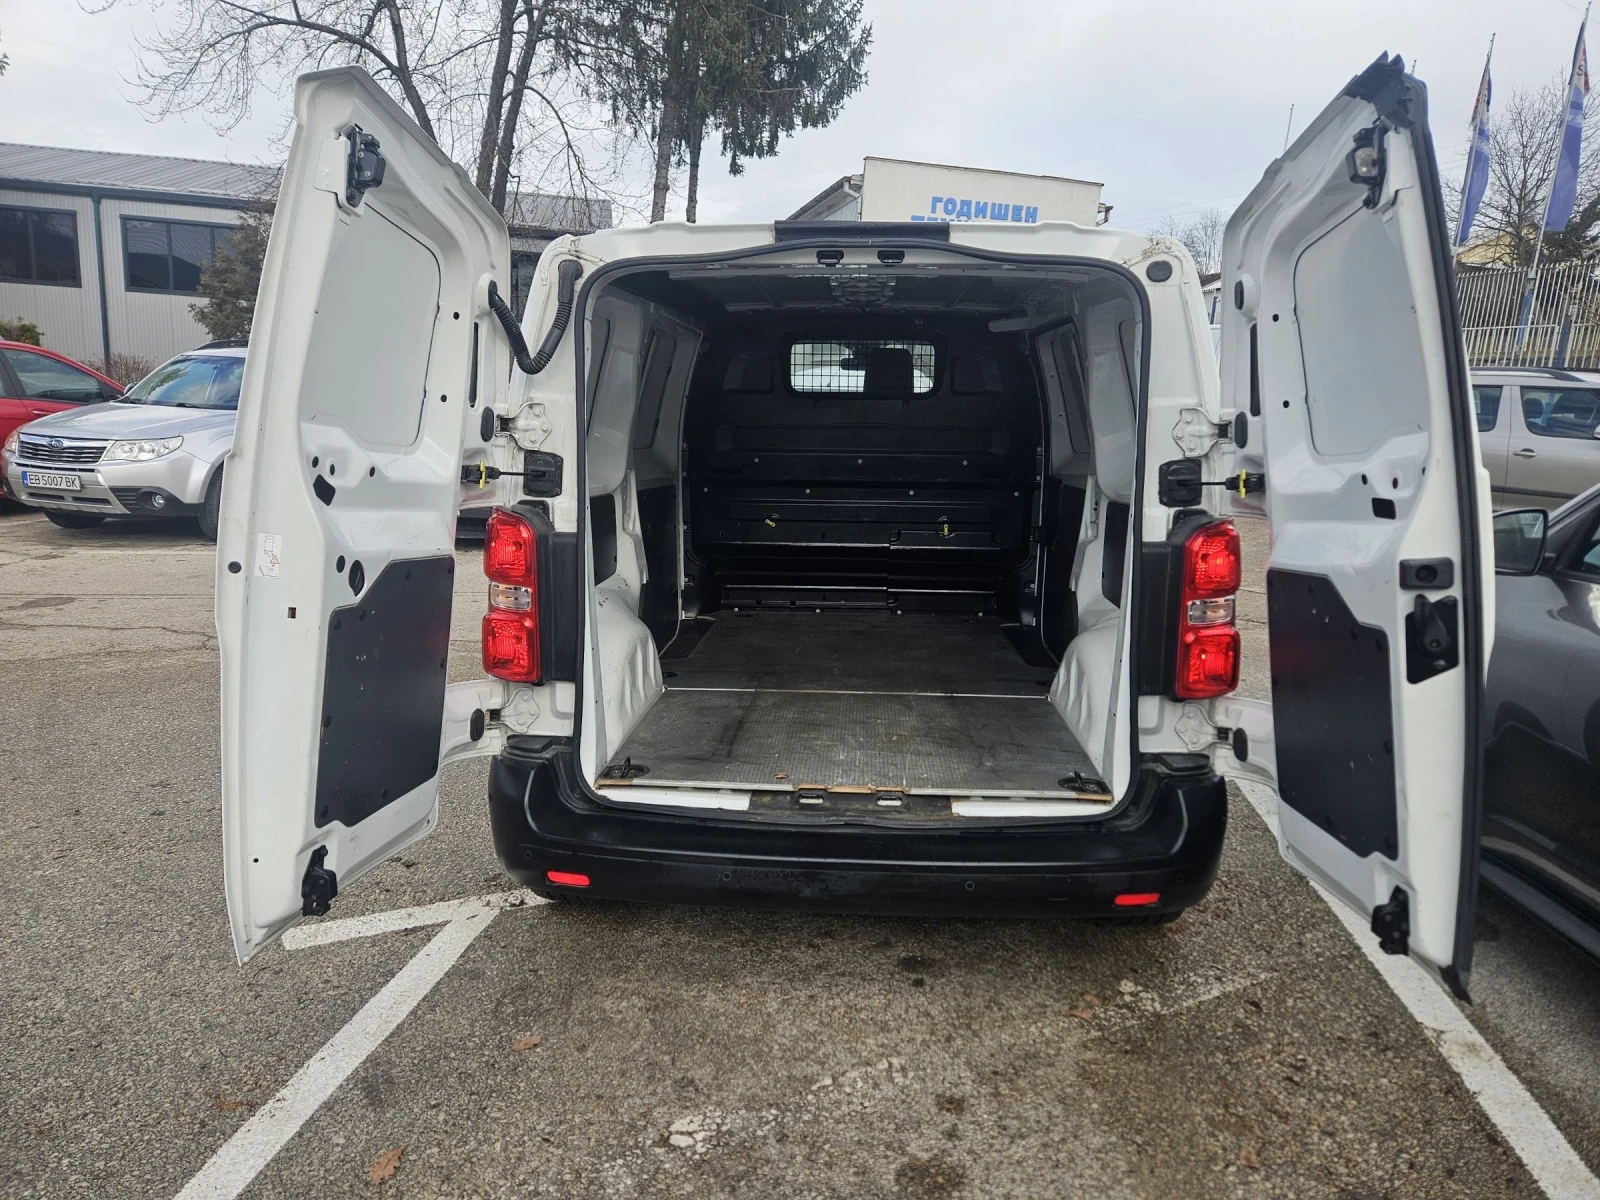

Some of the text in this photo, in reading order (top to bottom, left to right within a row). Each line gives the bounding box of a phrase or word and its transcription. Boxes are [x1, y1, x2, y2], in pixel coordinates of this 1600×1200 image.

[930, 196, 1038, 223] ГОДИШЕН
[28, 473, 40, 485] EB
[42, 475, 63, 487] 5007
[65, 477, 78, 488] BK
